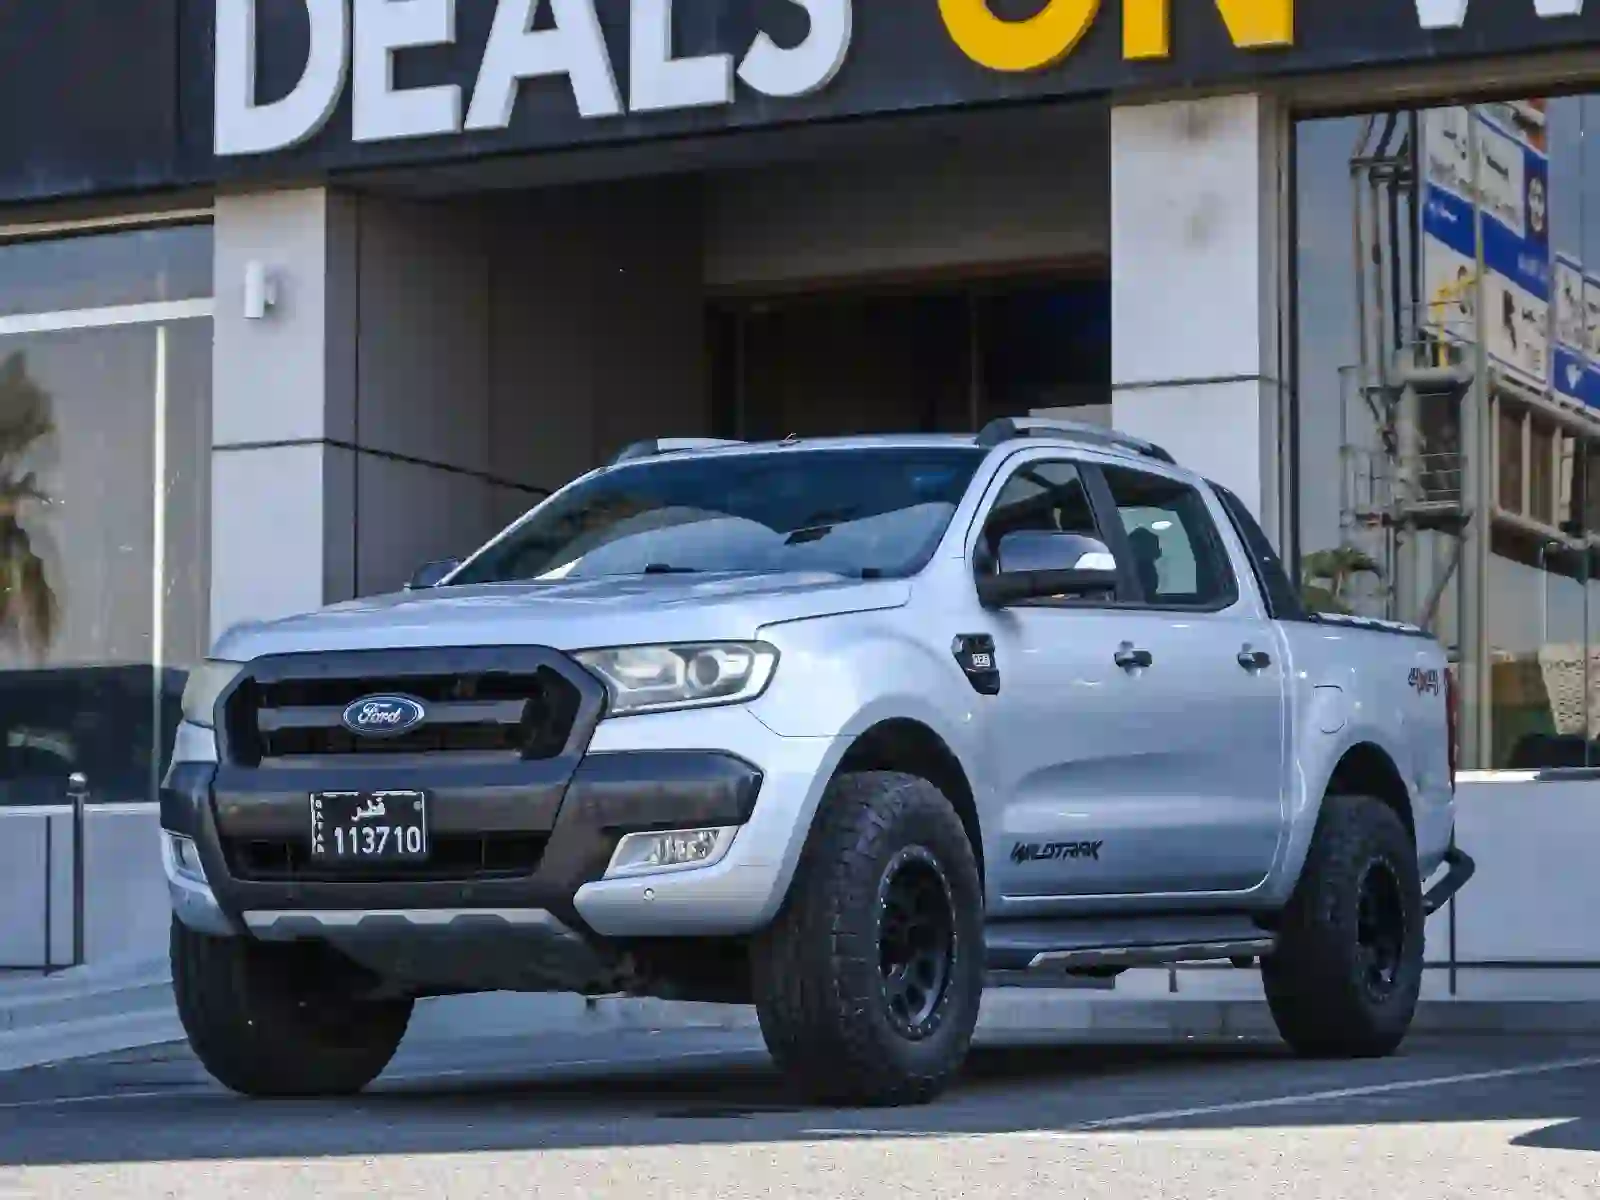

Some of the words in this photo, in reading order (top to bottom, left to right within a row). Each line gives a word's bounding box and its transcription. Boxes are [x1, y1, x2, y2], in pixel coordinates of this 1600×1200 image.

[357, 702, 402, 724] Ford
[334, 826, 421, 854] 113710
[1010, 840, 1103, 866] WILDTRAK
